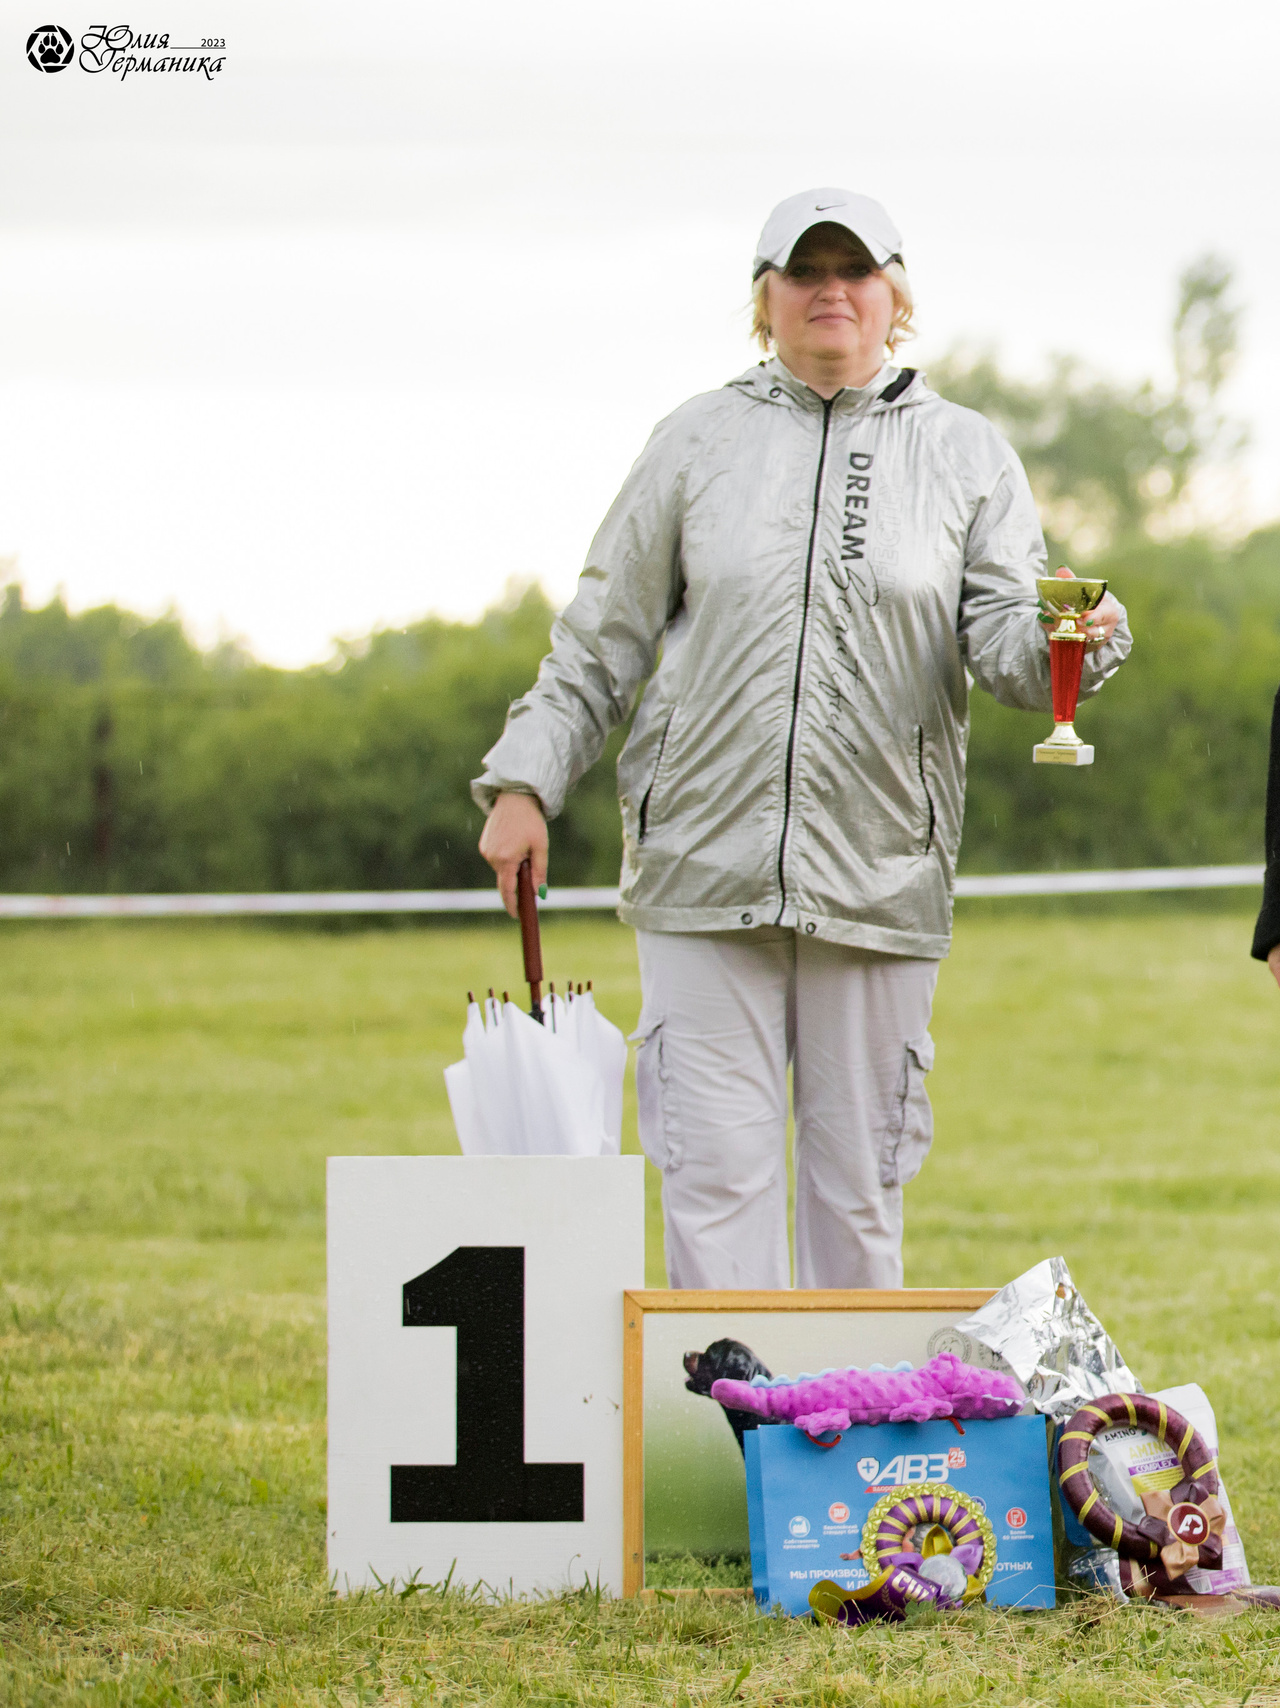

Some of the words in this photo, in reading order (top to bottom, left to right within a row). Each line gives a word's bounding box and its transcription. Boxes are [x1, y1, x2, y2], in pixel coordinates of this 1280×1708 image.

[841, 451, 874, 561] DREAM
[390, 1246, 584, 1522] 1
[1104, 1427, 1136, 1442] AMINO
[950, 1451, 965, 1463] 25
[1135, 1459, 1175, 1473] COMPLEX
[789, 1570, 808, 1580] МЫ
[993, 1561, 1033, 1572] ОТНЫХ
[846, 1581, 855, 1590] И
